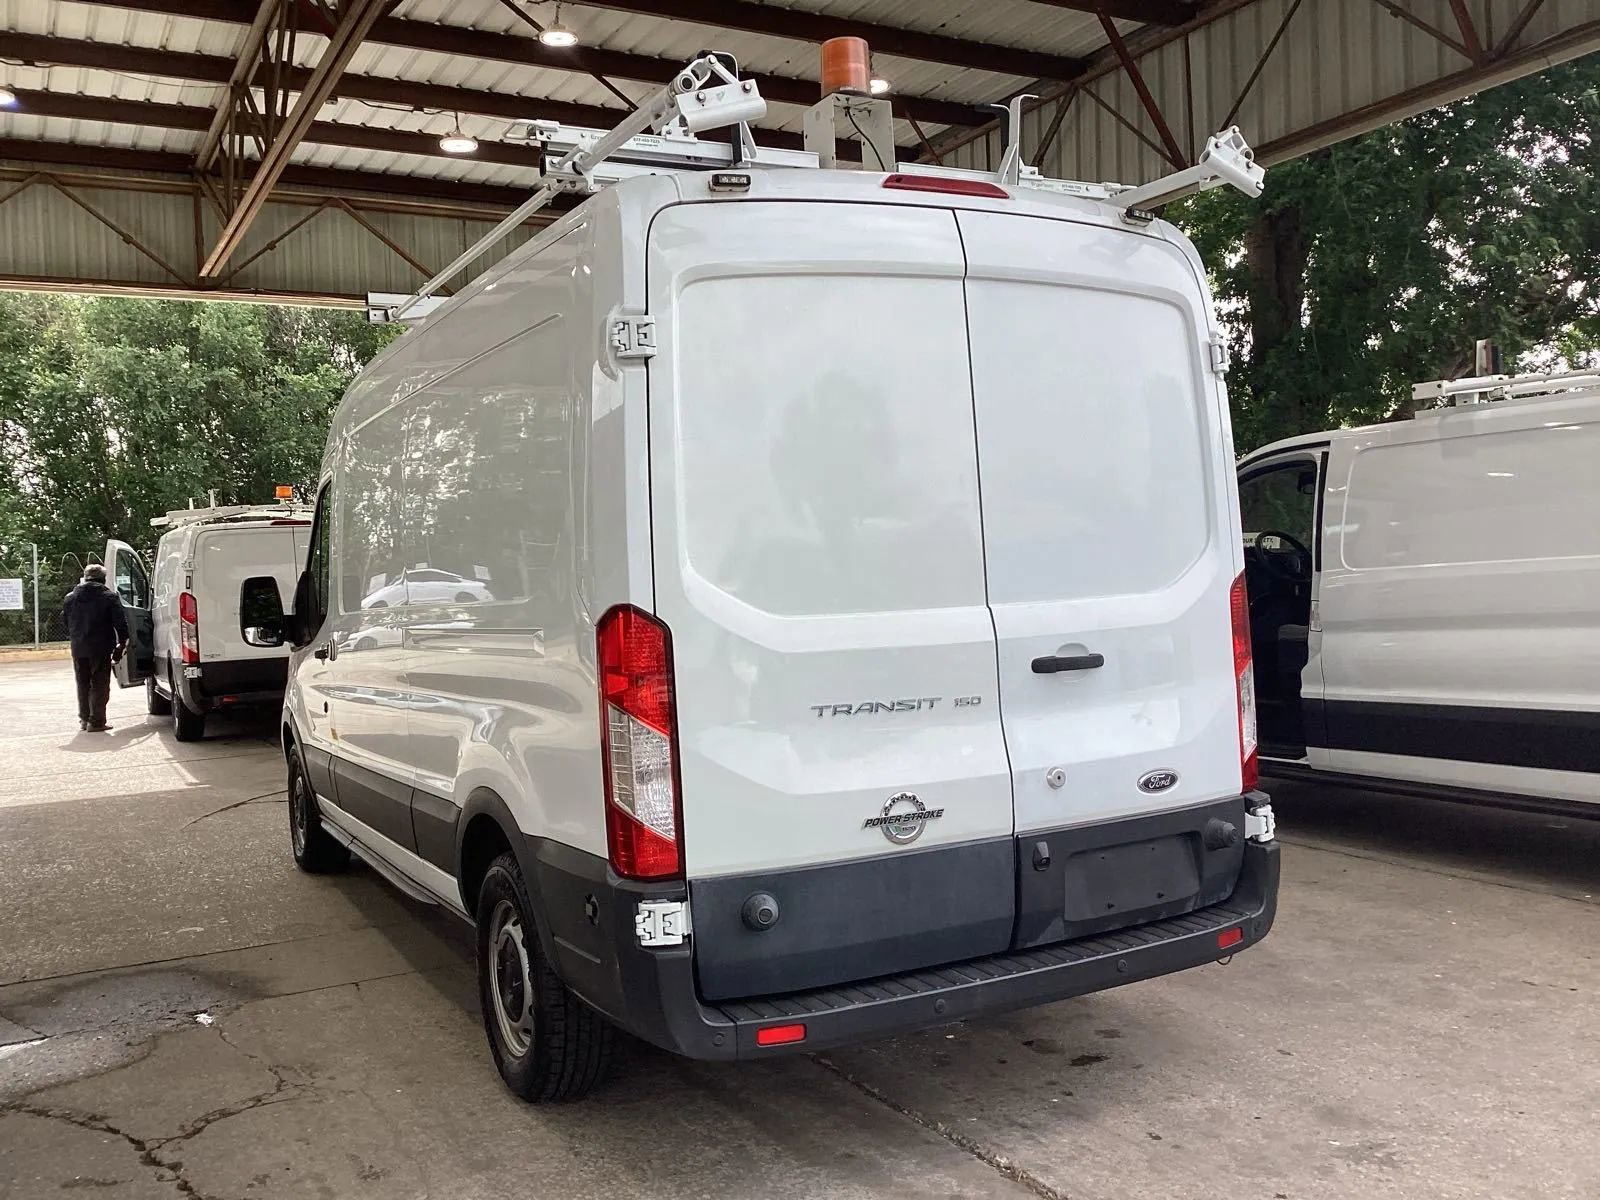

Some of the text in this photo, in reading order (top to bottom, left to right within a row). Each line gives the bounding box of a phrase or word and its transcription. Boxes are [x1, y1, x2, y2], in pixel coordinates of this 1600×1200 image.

[811, 696, 982, 717] TRANSIT 150
[1149, 774, 1171, 789] Ford
